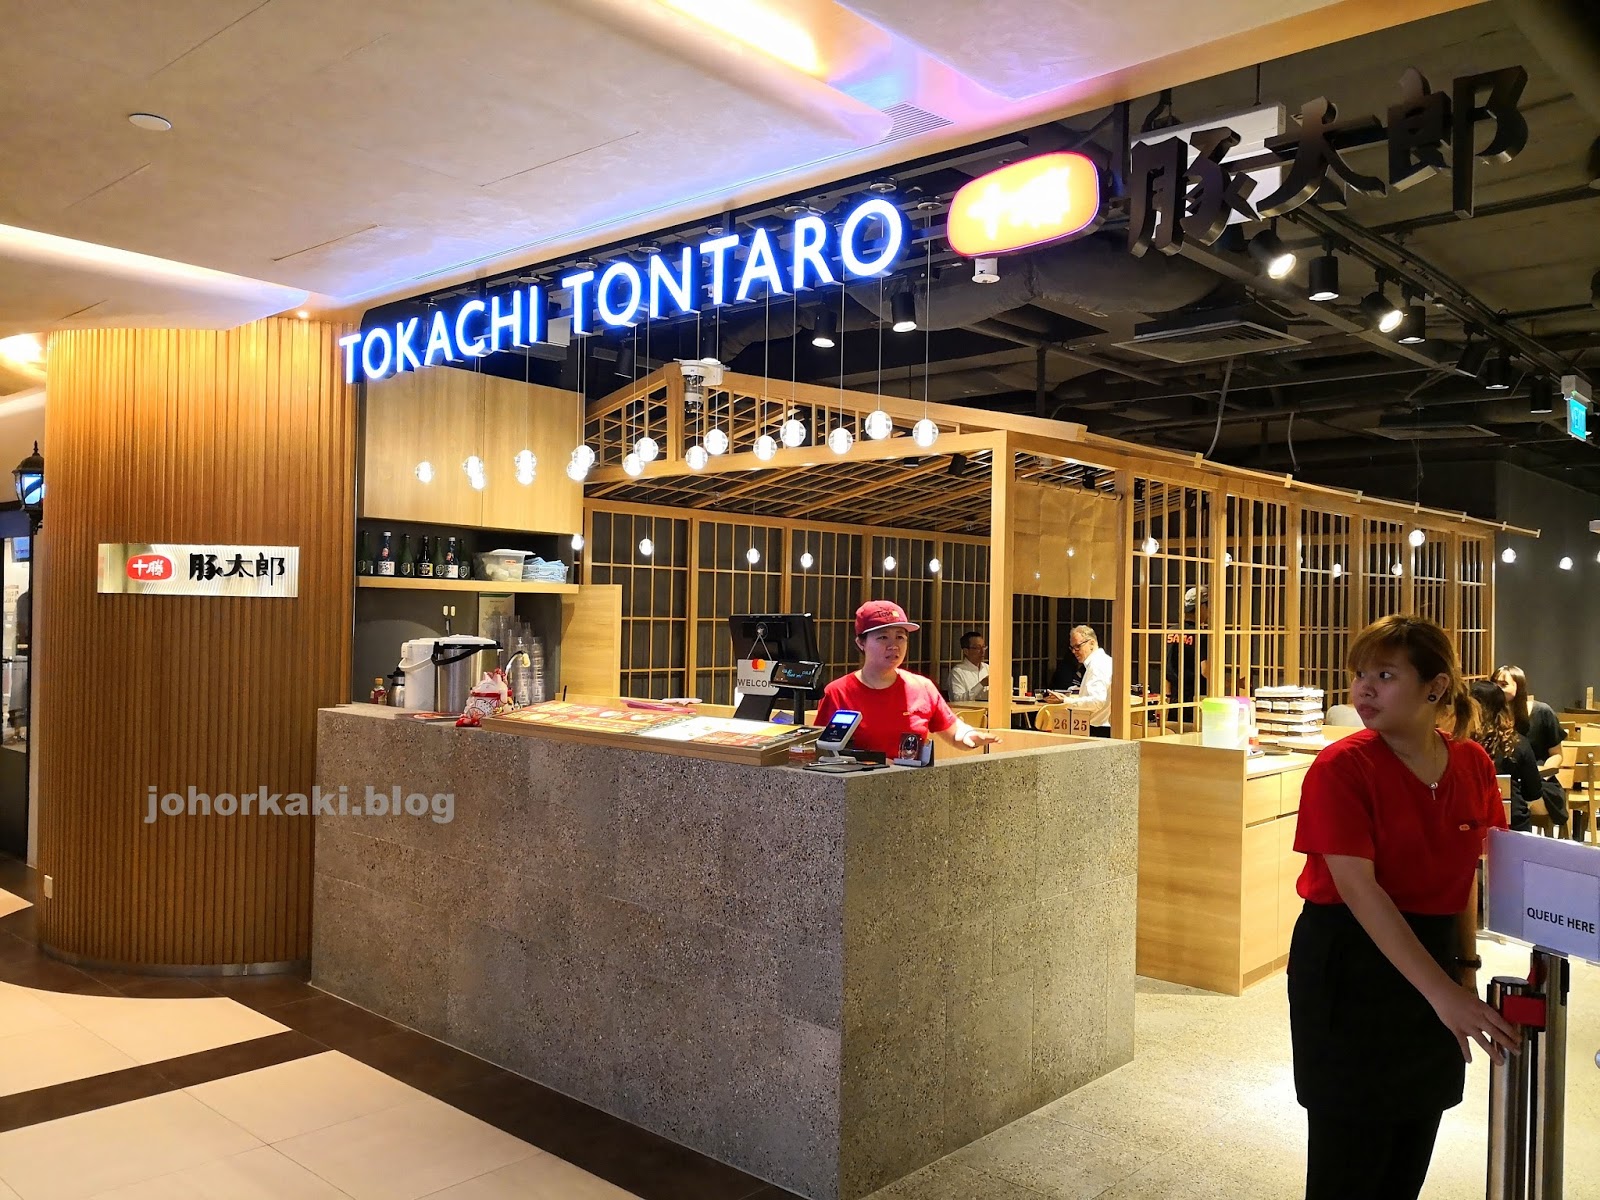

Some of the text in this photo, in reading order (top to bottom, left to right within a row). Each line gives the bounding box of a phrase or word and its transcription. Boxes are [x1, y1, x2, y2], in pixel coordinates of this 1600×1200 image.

[339, 198, 905, 383] TOKACHI TONTARO
[132, 552, 285, 586] 十勝 豚太郎
[1054, 718, 1067, 730] 26
[1073, 719, 1087, 731] 25
[1527, 907, 1595, 934] QUEUE HERE
